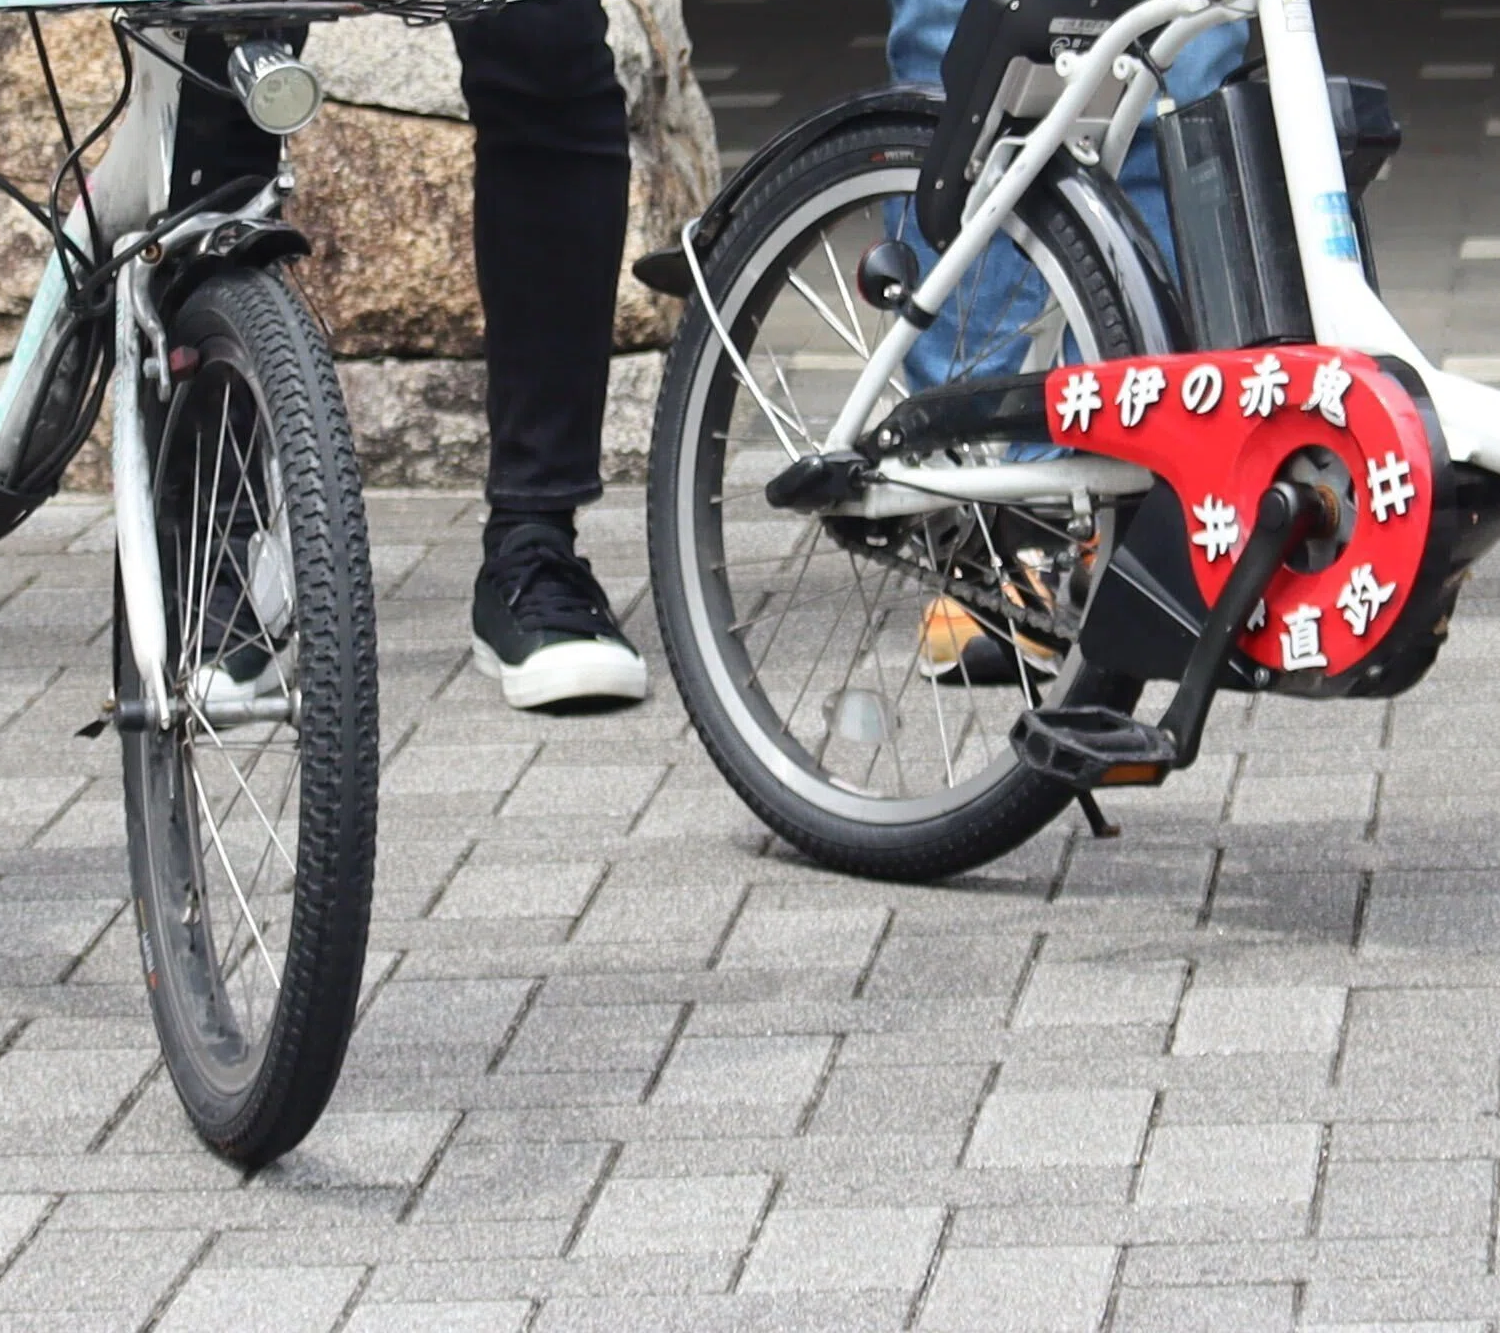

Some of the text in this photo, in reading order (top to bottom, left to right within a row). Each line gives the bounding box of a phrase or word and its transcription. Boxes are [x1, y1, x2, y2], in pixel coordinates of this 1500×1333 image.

[1055, 355, 1353, 430] 井伊の赤鬼
